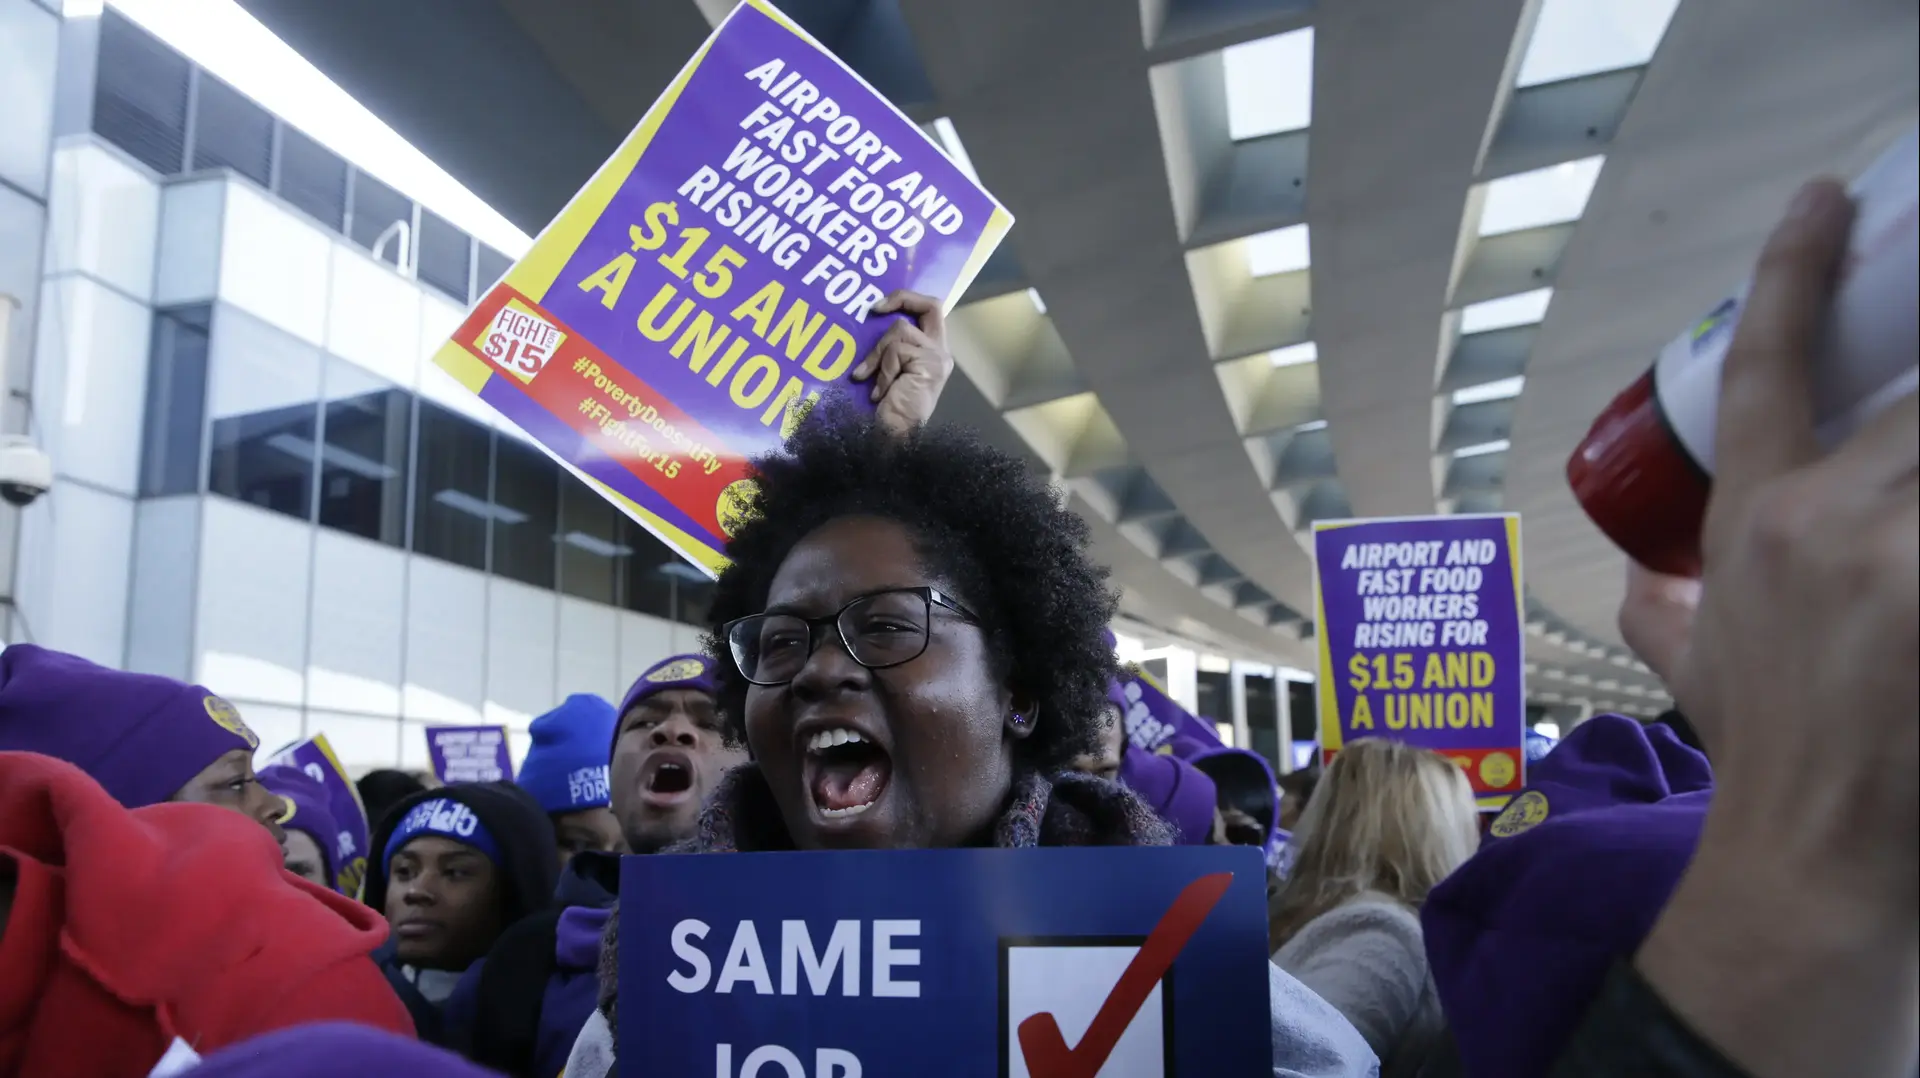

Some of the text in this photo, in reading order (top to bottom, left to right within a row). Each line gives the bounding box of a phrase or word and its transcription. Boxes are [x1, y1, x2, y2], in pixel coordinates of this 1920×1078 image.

[744, 58, 963, 235] AIRPORT AND
[739, 101, 925, 247] FAST FOOD
[722, 137, 897, 276] WORKERS
[677, 164, 885, 324] RISING FOR
[629, 201, 857, 382] $15 AND
[496, 308, 558, 346] FIGHT
[545, 330, 557, 349] FOR
[577, 252, 819, 440] A UNION
[485, 332, 546, 374] $15
[578, 397, 682, 479] #FightFor15
[1341, 539, 1496, 569] AIRPORT AND
[1357, 566, 1483, 595] FAST FOOD
[1363, 593, 1479, 621] WORKERS
[1354, 620, 1489, 648] RISING FOR
[1348, 651, 1495, 693] $15 AND
[1351, 692, 1494, 729] A UNION
[570, 780, 608, 804] POR
[666, 919, 921, 998] SAME
